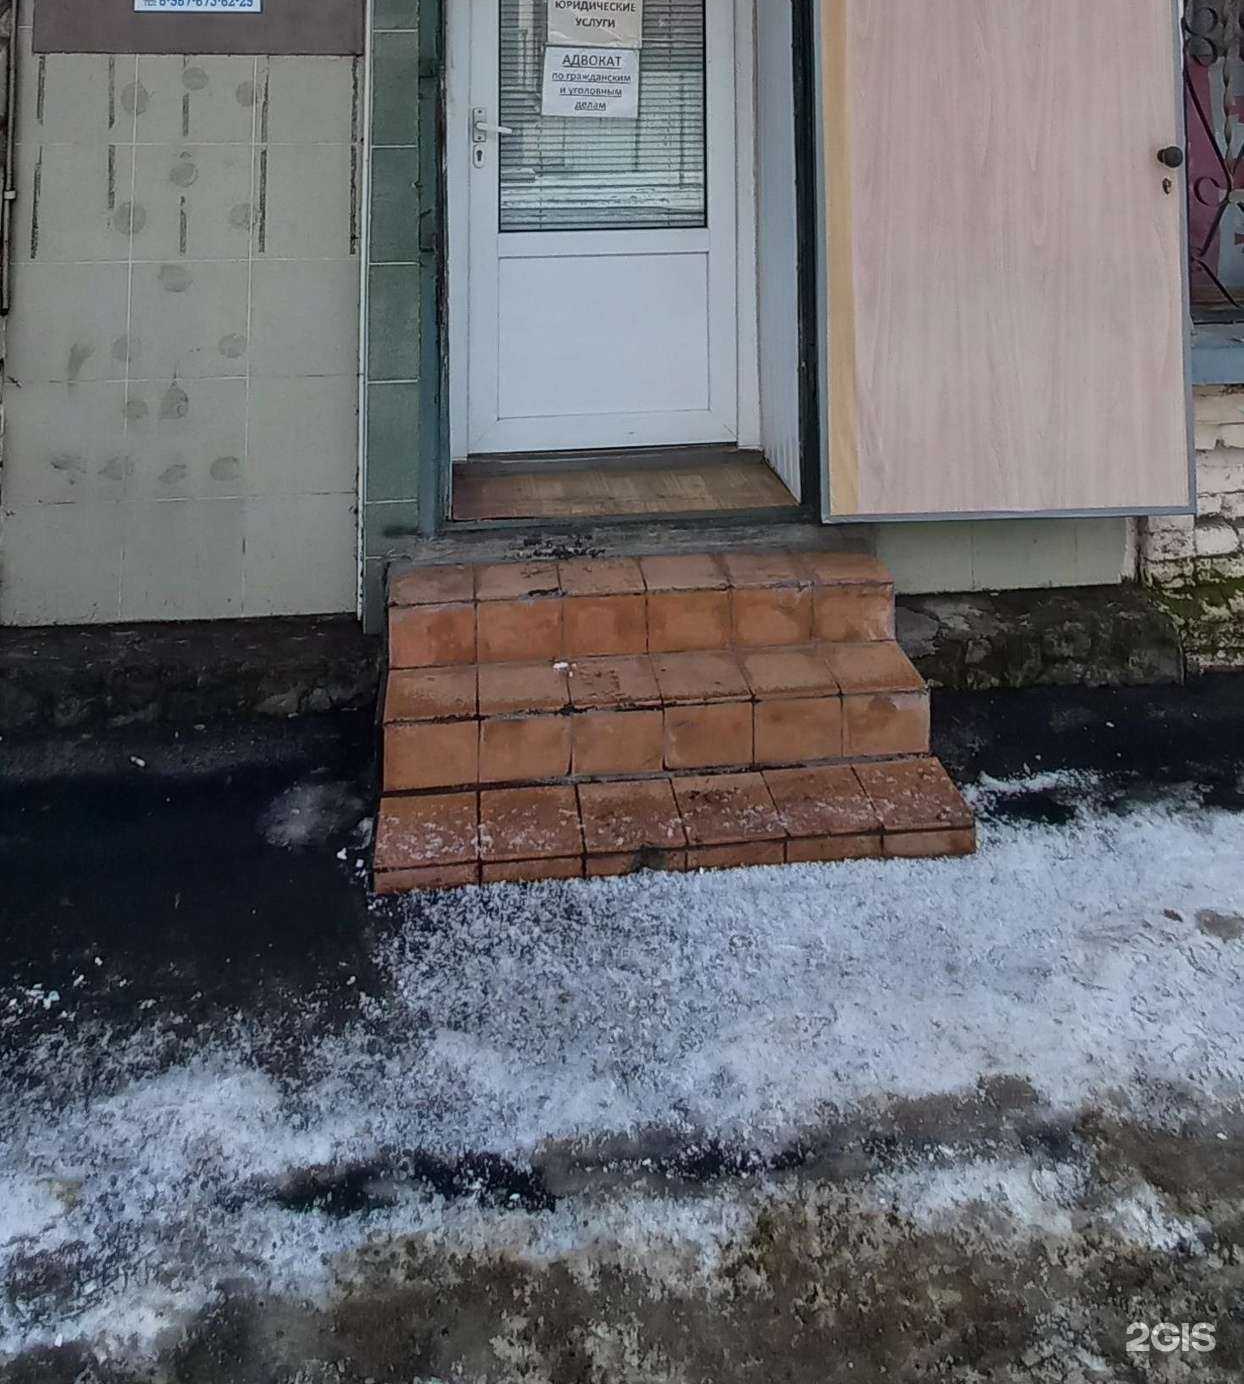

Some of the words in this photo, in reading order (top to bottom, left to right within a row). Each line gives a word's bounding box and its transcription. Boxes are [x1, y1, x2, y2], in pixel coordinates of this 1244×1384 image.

[555, 0, 637, 13] ЮРИДИЧЕСКИЕ
[575, 17, 615, 28] УСЛУГИ
[562, 54, 622, 68] АДВОКАТ
[566, 73, 631, 84] гражданским
[569, 87, 622, 96] уголовным
[575, 102, 606, 111] делам
